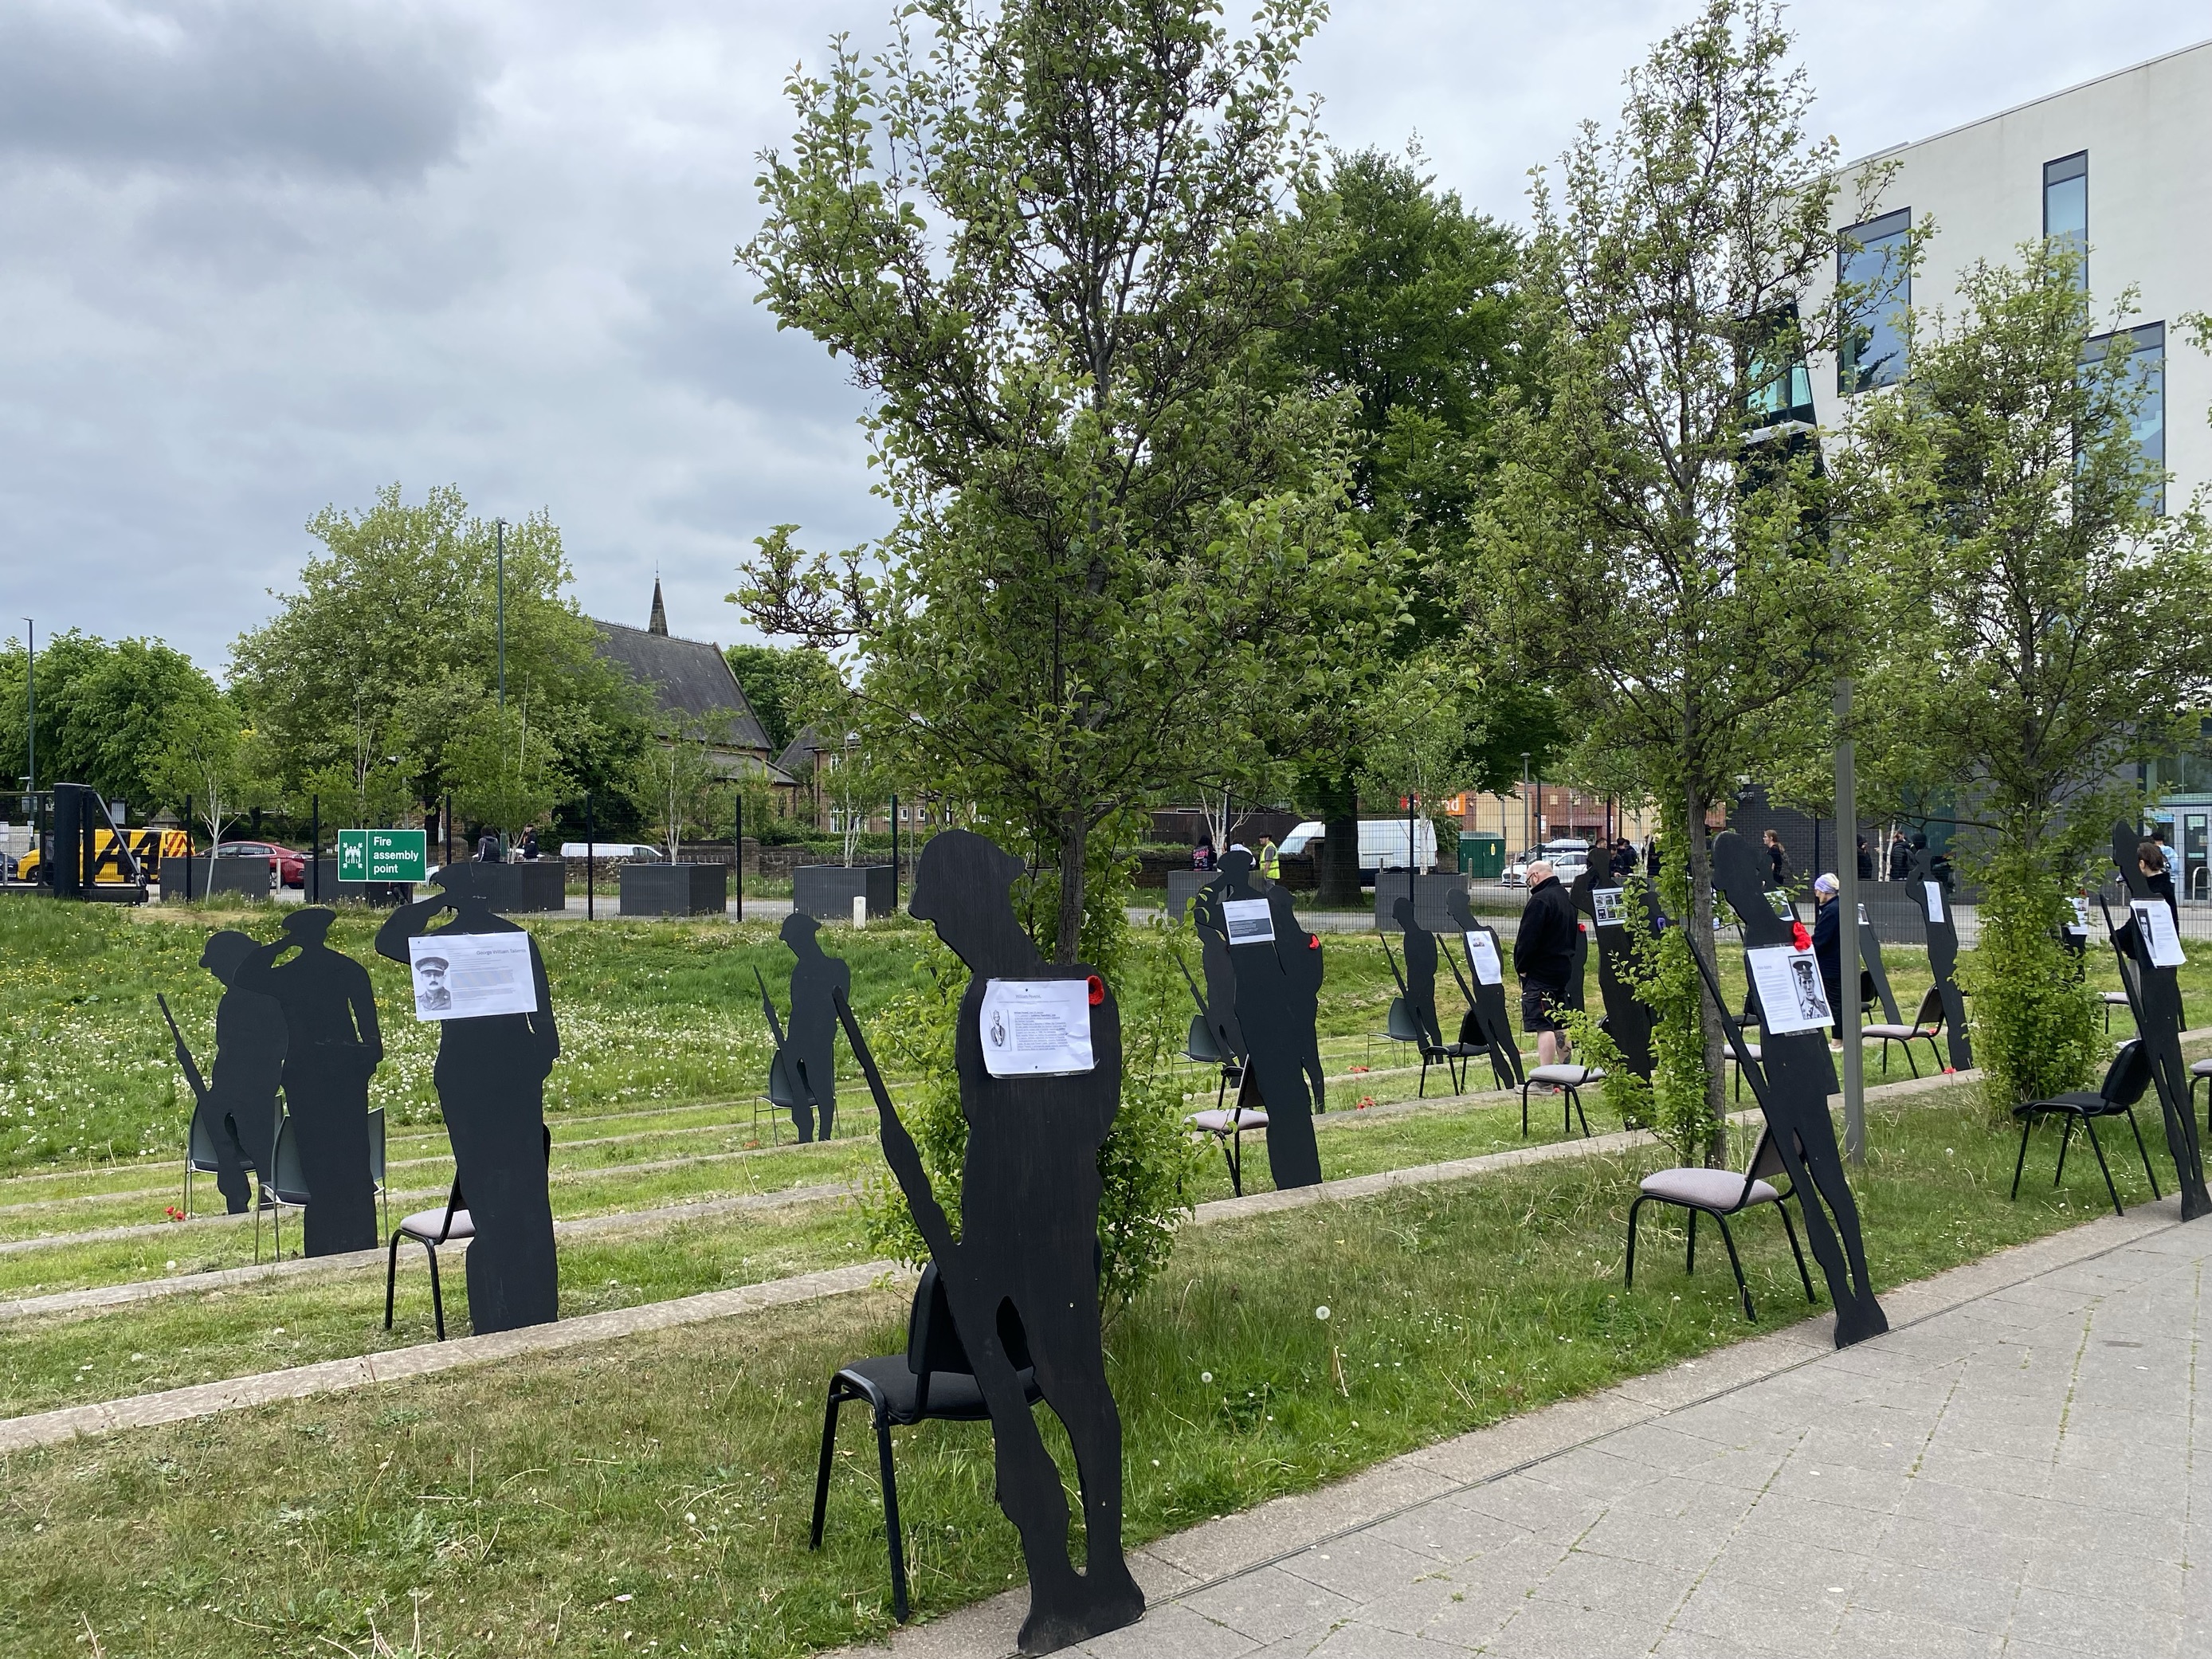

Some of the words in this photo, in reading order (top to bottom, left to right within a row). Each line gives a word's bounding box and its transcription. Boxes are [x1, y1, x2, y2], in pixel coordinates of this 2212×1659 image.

[373, 836, 392, 846] Fire
[94, 830, 162, 875] AA
[373, 850, 419, 861] assembly
[373, 864, 398, 875] point
